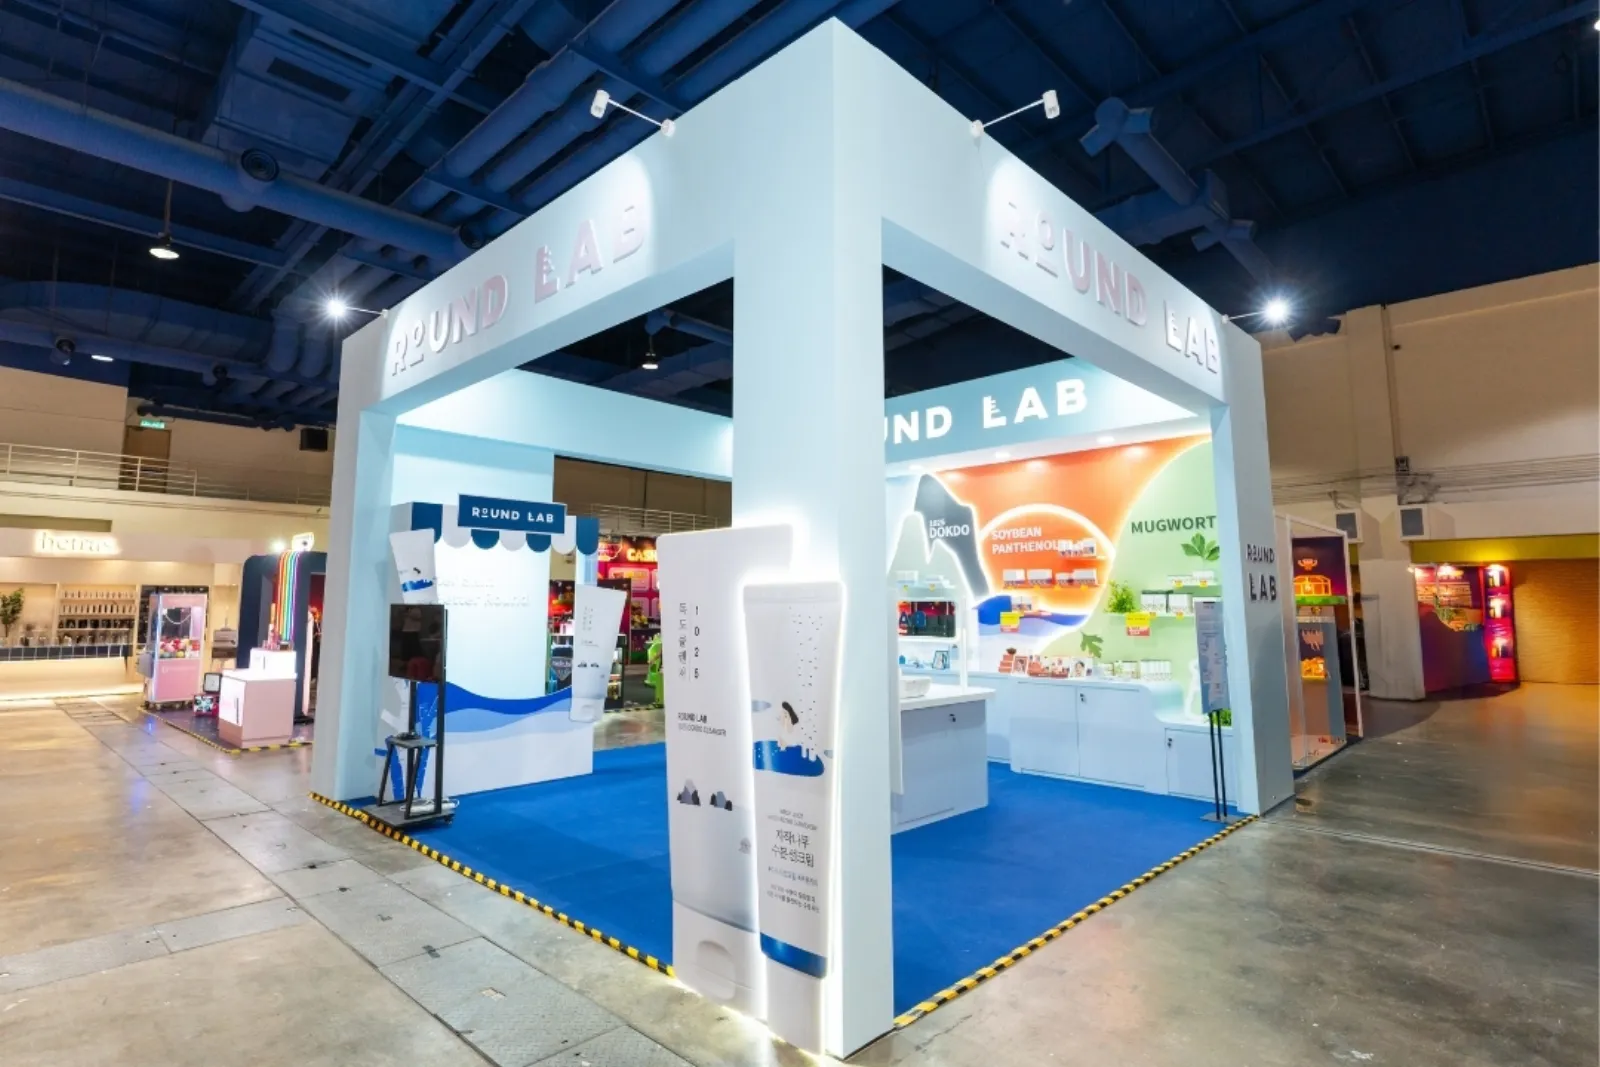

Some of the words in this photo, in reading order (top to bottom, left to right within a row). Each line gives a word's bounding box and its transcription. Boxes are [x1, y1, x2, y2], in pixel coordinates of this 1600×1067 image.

[391, 273, 509, 377] ROUND
[534, 204, 648, 304] LAB
[1163, 299, 1221, 375] LAB
[982, 378, 1088, 429] LAB
[471, 506, 521, 521] ROUND
[527, 511, 554, 523] LAB
[1131, 515, 1217, 534] MUGWORT
[929, 524, 970, 539] DOKDO
[991, 526, 1042, 541] SOYBEAN
[1247, 543, 1275, 564] ROUND
[1249, 573, 1277, 601] LAB
